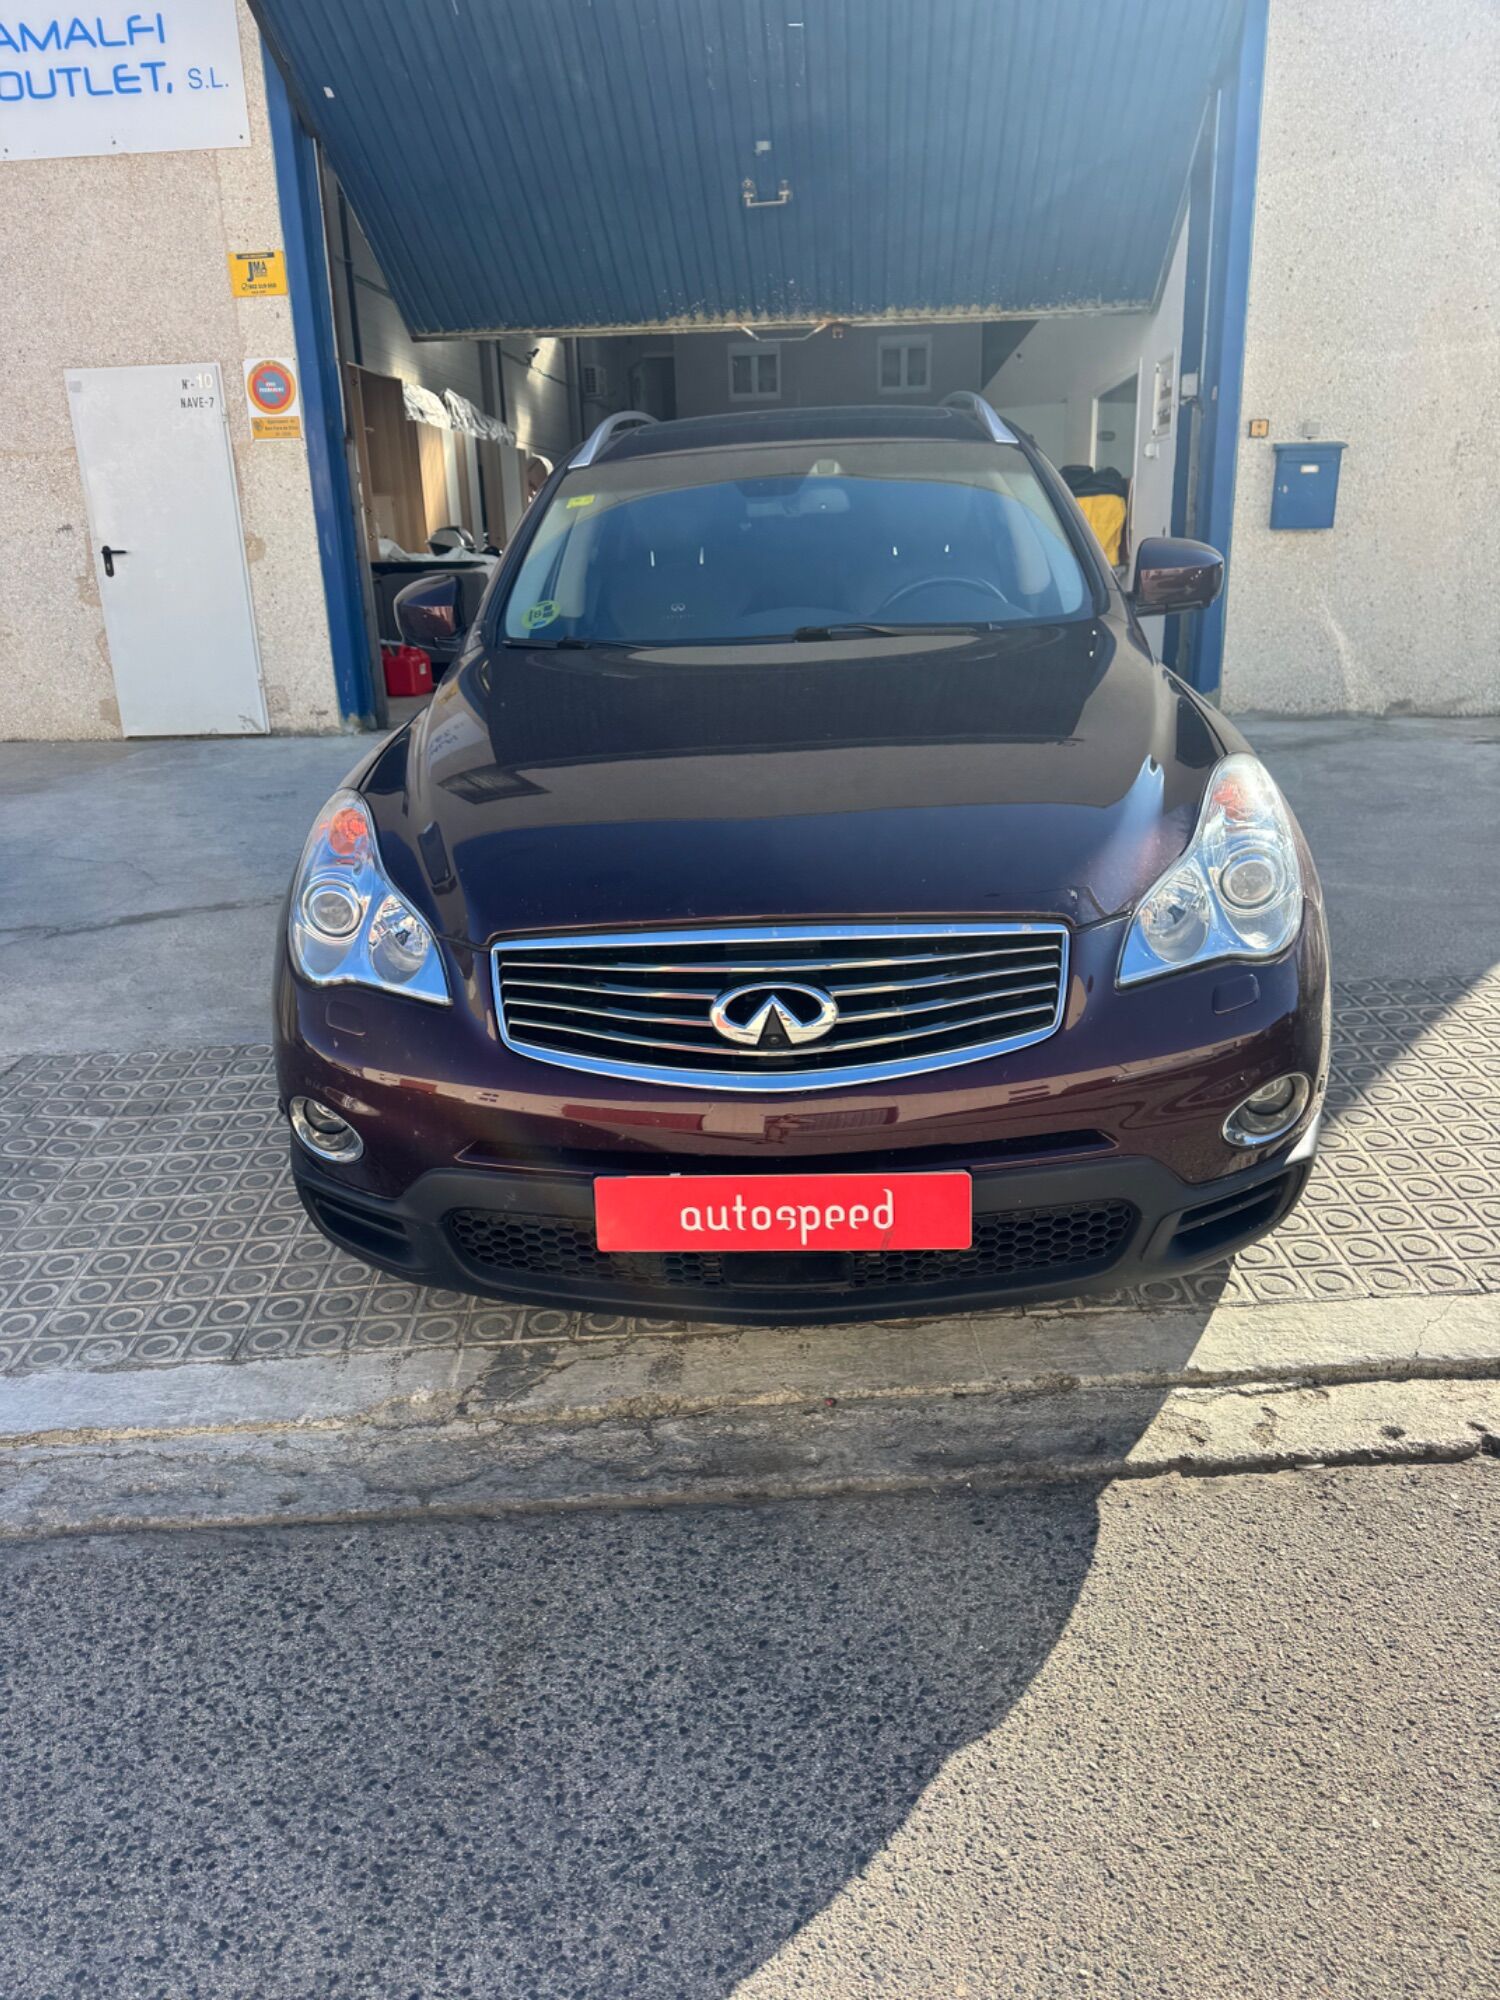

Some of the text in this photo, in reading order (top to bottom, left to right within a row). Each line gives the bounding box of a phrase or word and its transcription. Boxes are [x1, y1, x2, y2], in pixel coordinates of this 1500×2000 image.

[0, 13, 166, 53] AMALFI
[0, 61, 229, 101] OUTLET, S.L.
[180, 396, 214, 409] NAVE-7
[680, 1188, 894, 1246] autospeed
